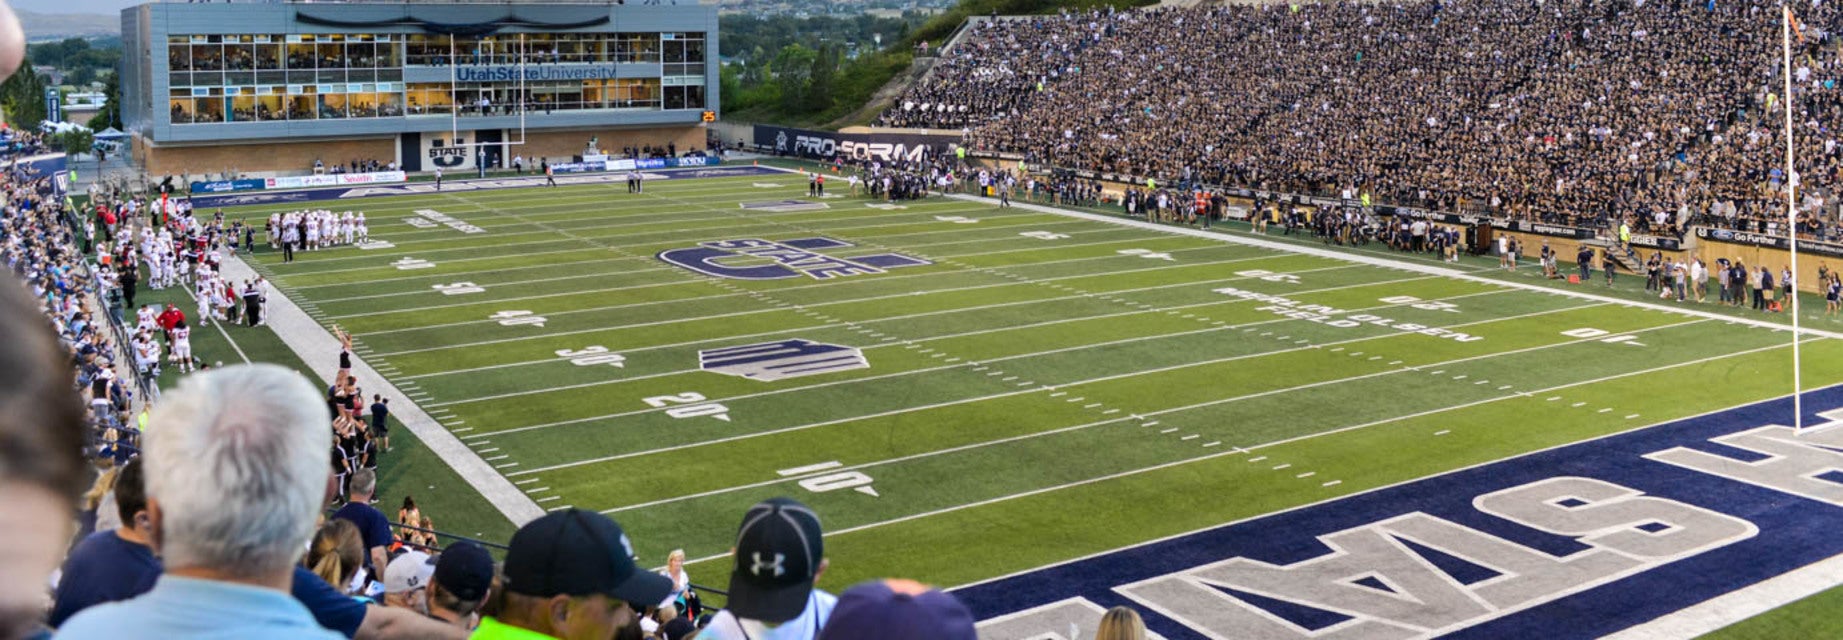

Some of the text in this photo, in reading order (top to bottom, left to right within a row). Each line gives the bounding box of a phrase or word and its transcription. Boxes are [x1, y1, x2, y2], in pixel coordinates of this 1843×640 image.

[429, 147, 468, 159] STATE
[1734, 232, 1747, 241] Go
[1747, 234, 1777, 245] Further
[697, 237, 888, 280] STATE
[489, 310, 548, 326] 40
[1347, 314, 1484, 342] OLSEN
[555, 345, 626, 367] 30
[642, 391, 730, 419] 20
[776, 460, 874, 493] 10
